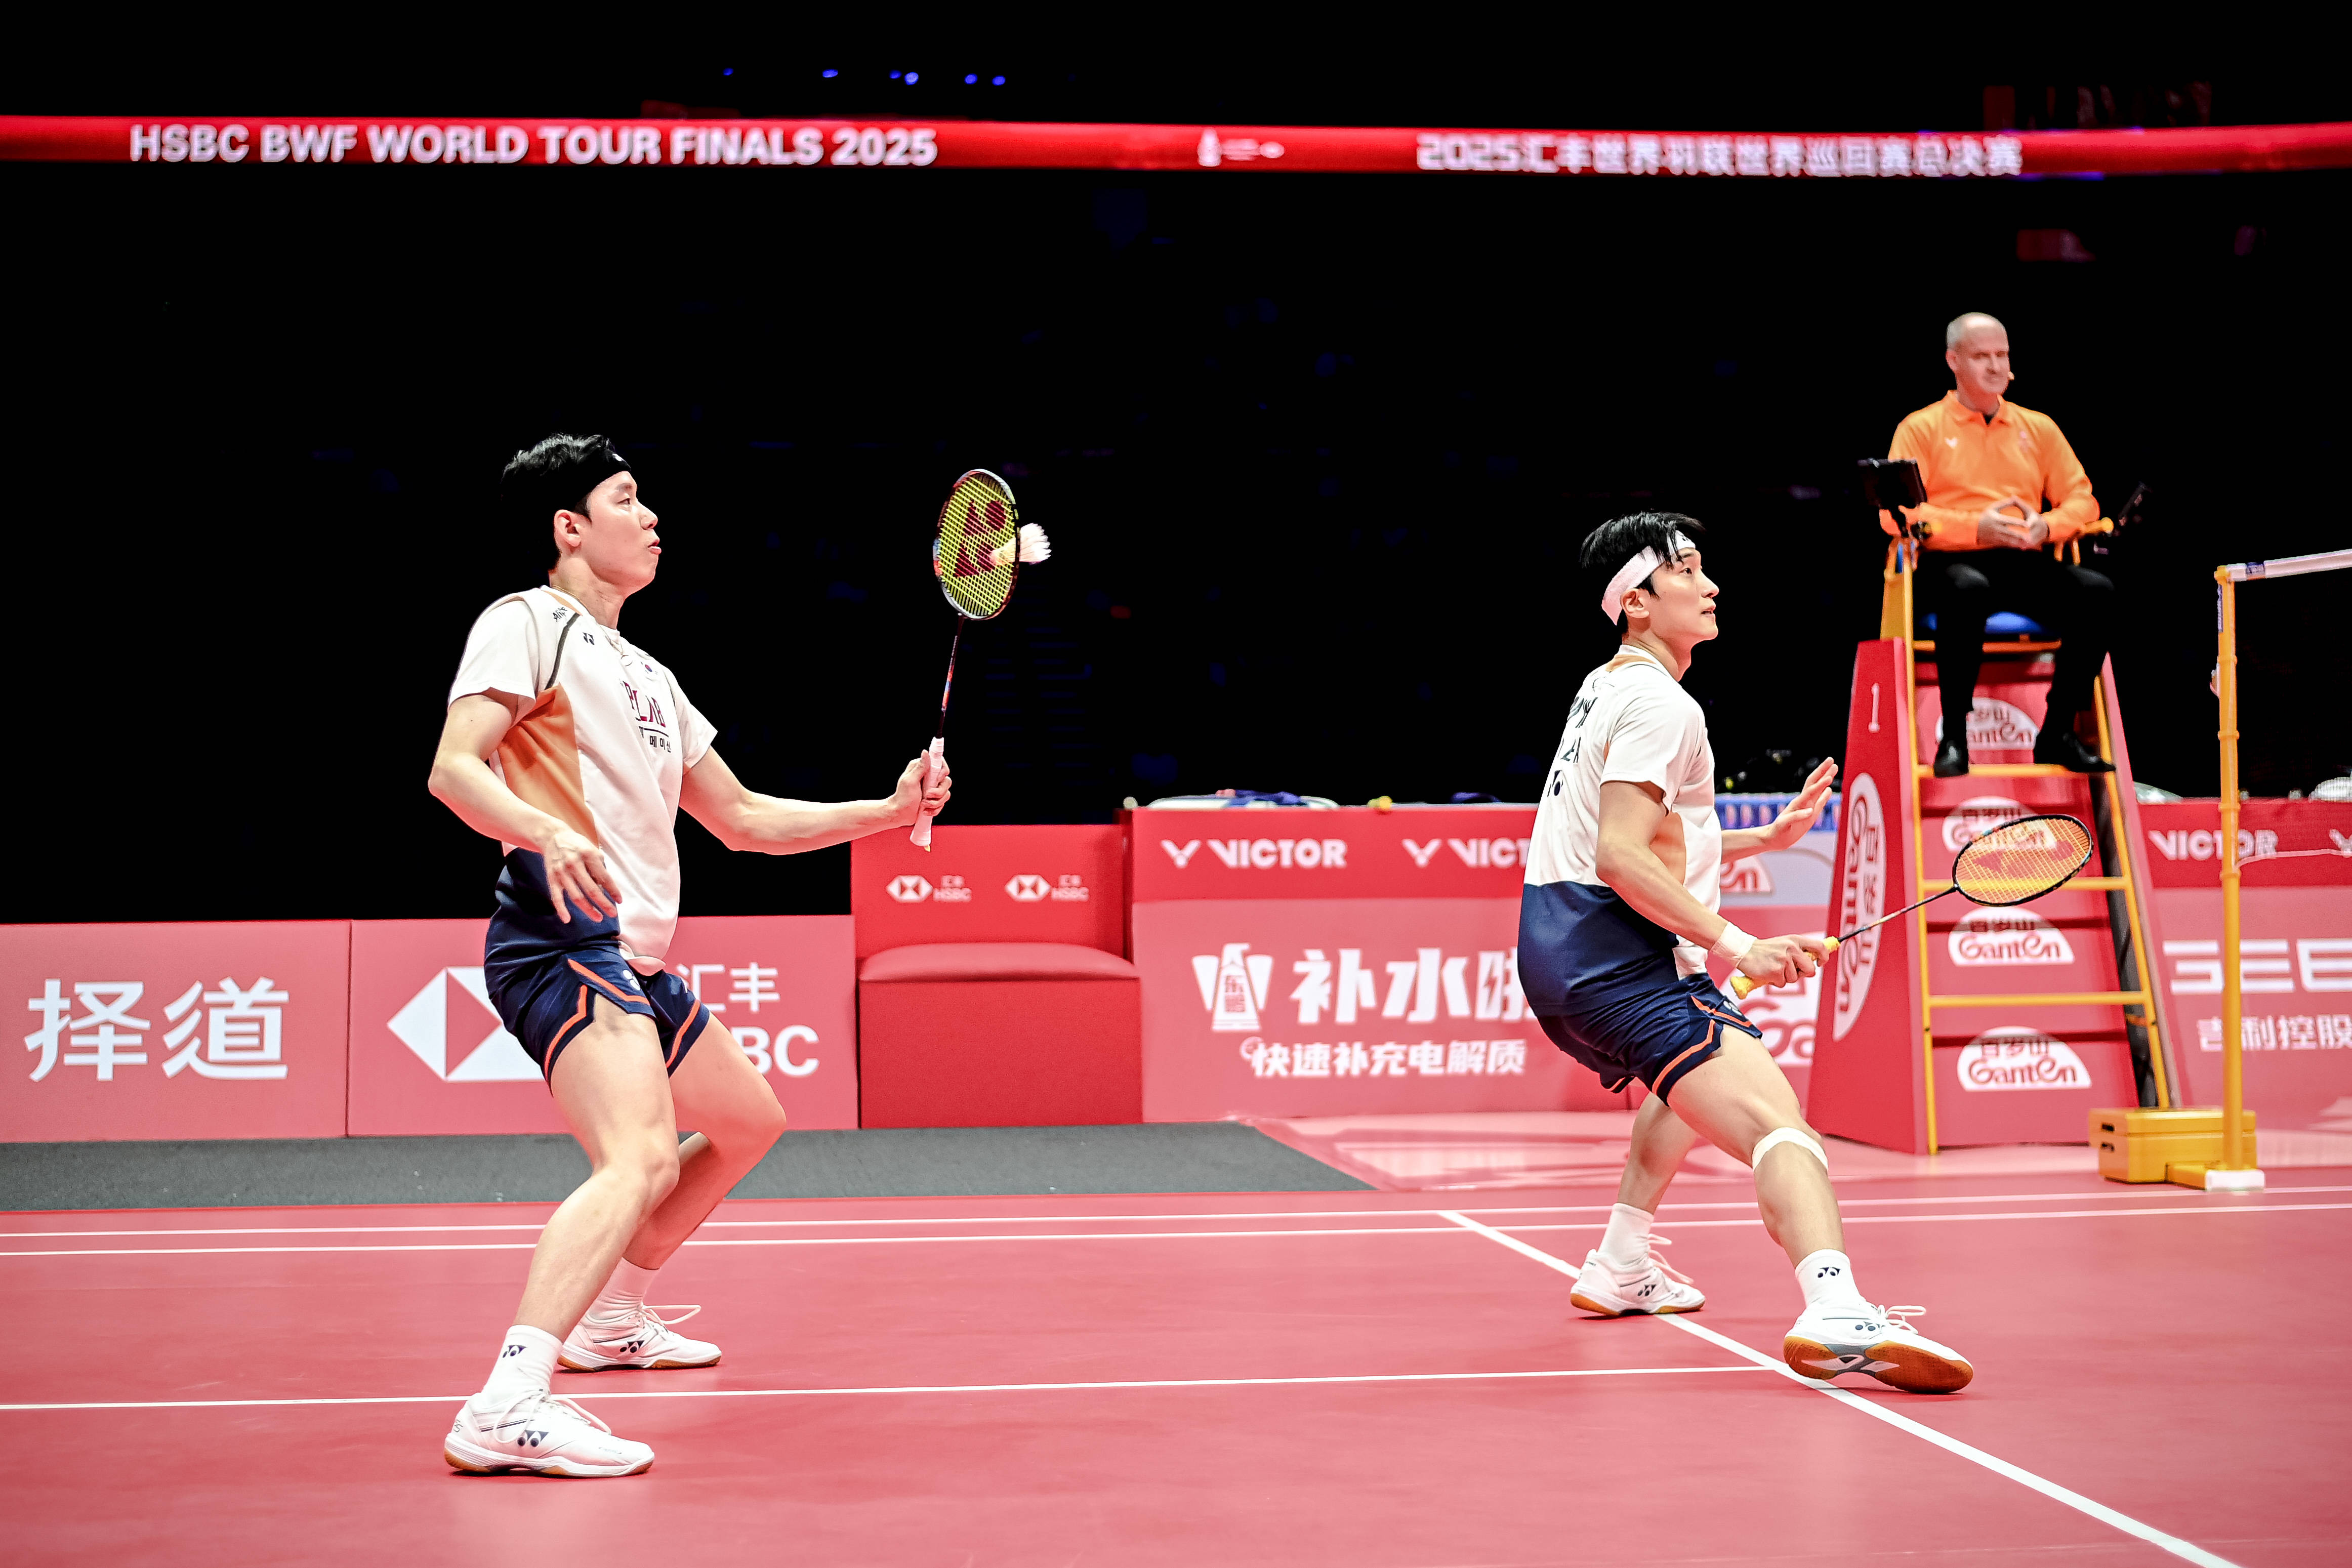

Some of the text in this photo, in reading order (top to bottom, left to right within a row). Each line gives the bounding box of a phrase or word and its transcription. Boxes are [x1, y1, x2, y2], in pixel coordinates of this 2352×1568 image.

[131, 125, 937, 166] HSBC BWF WORLD TOUR FINALS 2025
[1207, 838, 1347, 869] VICTOR
[1448, 837, 1531, 868] VICT
[1958, 933, 2061, 960] Ganten
[677, 962, 780, 1012] 汇丰
[24, 977, 289, 1082] 择道
[730, 1024, 819, 1077] BC
[1251, 1038, 1526, 1077] 快速补充电解质
[1969, 1057, 2077, 1086] Ganten
